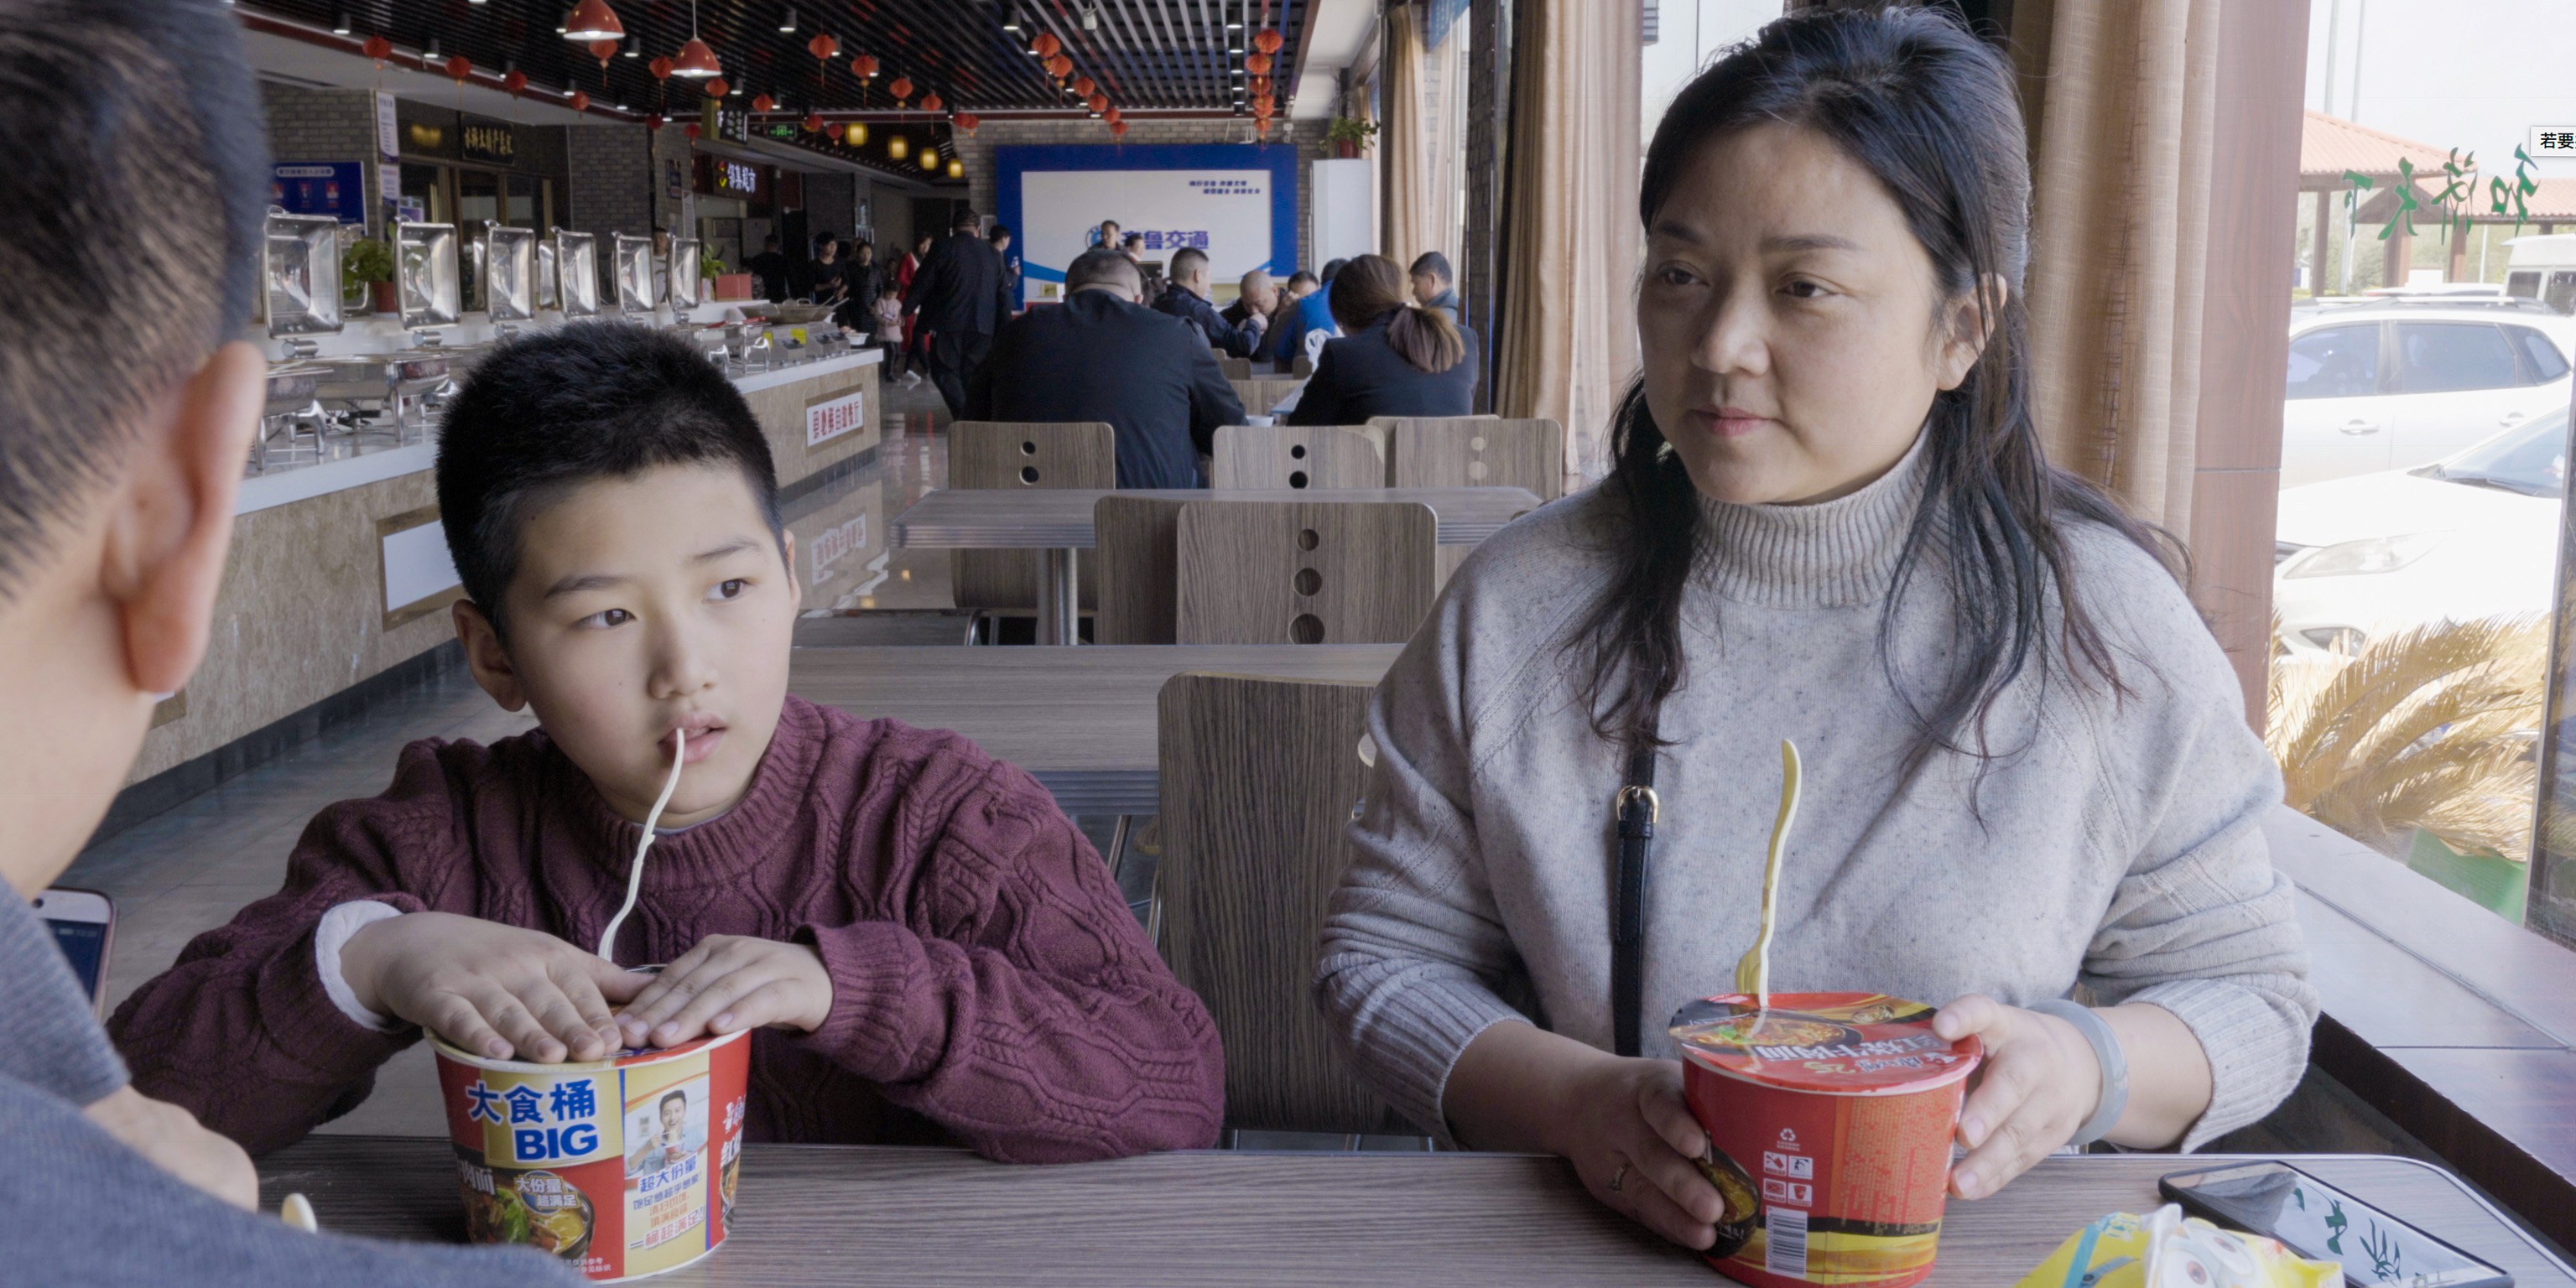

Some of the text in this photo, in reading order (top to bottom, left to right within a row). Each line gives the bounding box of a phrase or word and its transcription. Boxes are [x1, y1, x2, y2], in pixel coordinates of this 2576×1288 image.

[467, 1079, 596, 1124] 大食桶
[516, 1124, 599, 1161] BIG
[516, 1177, 563, 1193] 大份量
[640, 1155, 697, 1193] 超大份量
[536, 1195, 577, 1208] 超满足
